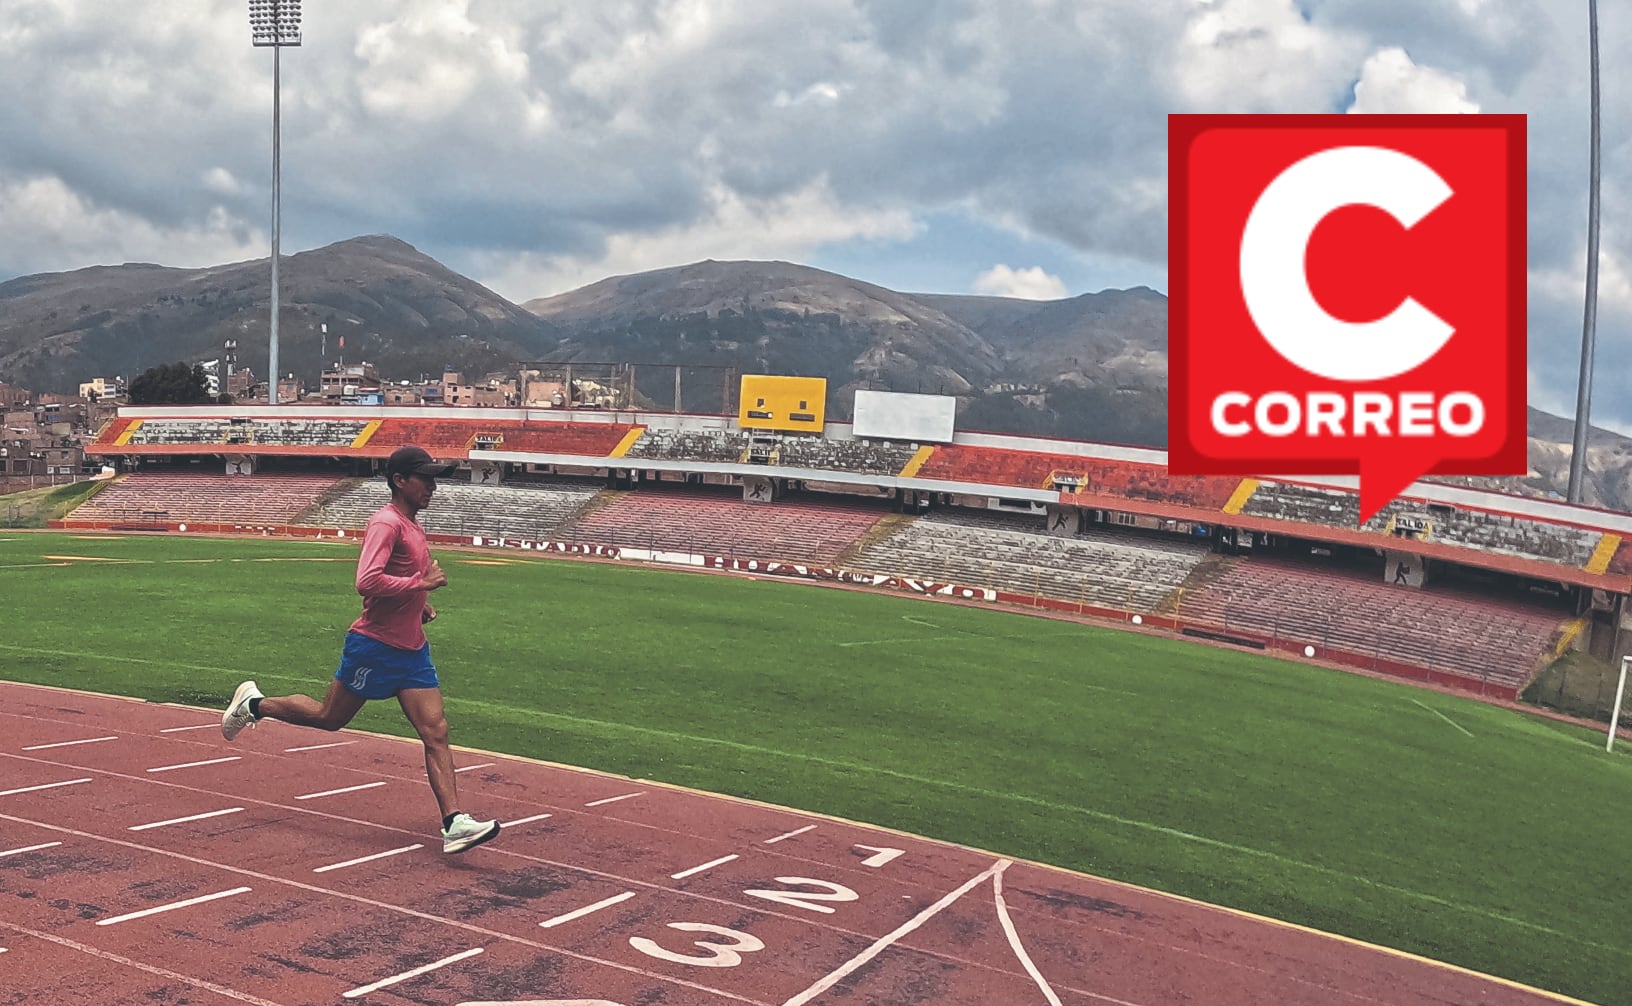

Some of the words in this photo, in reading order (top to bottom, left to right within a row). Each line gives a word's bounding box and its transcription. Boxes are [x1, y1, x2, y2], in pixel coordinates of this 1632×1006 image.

[481, 537, 621, 557] ESTADIO
[705, 555, 985, 598] HUANCAYO
[853, 842, 906, 868] 1
[742, 875, 860, 914] 2
[628, 921, 766, 968] 3
